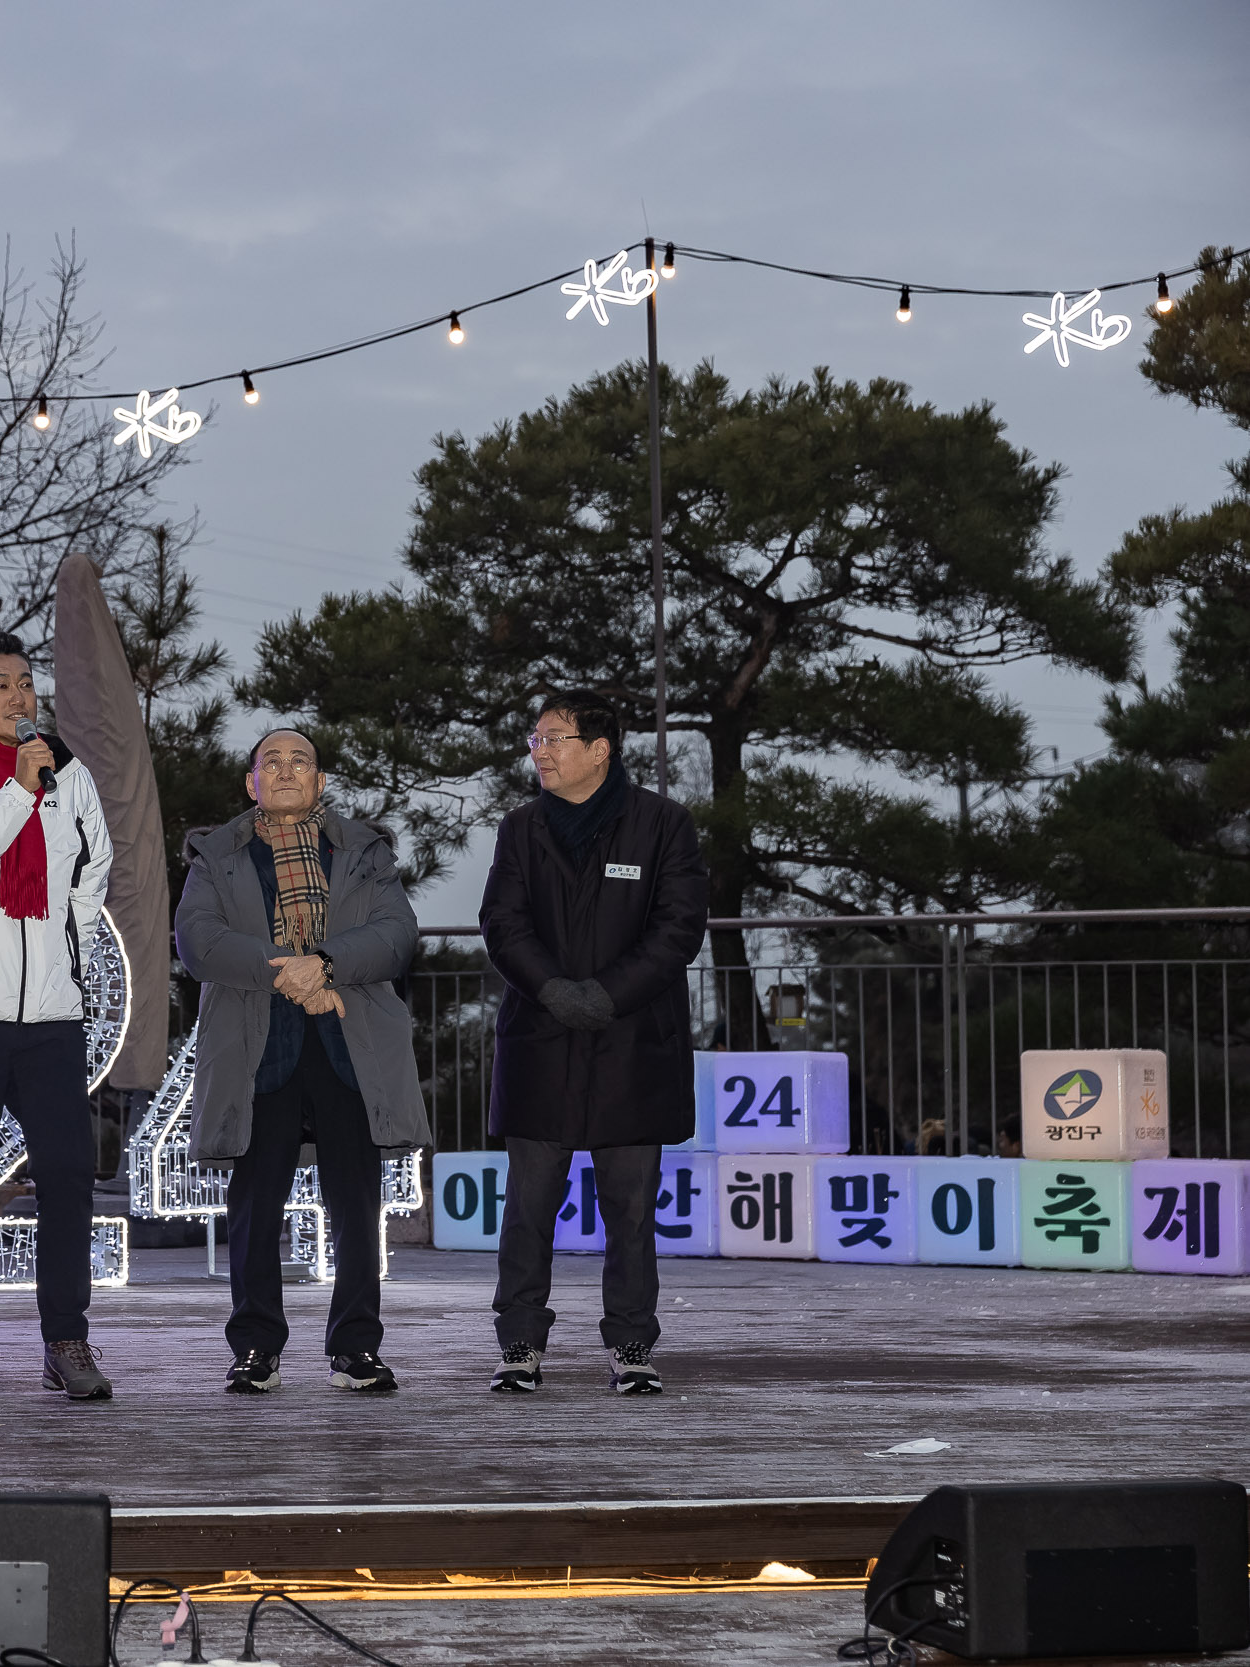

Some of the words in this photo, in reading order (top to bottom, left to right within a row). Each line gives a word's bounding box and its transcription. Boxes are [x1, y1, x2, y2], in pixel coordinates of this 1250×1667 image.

[44, 800, 58, 809] K2
[723, 1075, 801, 1128] 24
[1044, 1125, 1103, 1141] 광진구
[1033, 1172, 1221, 1259] 축제
